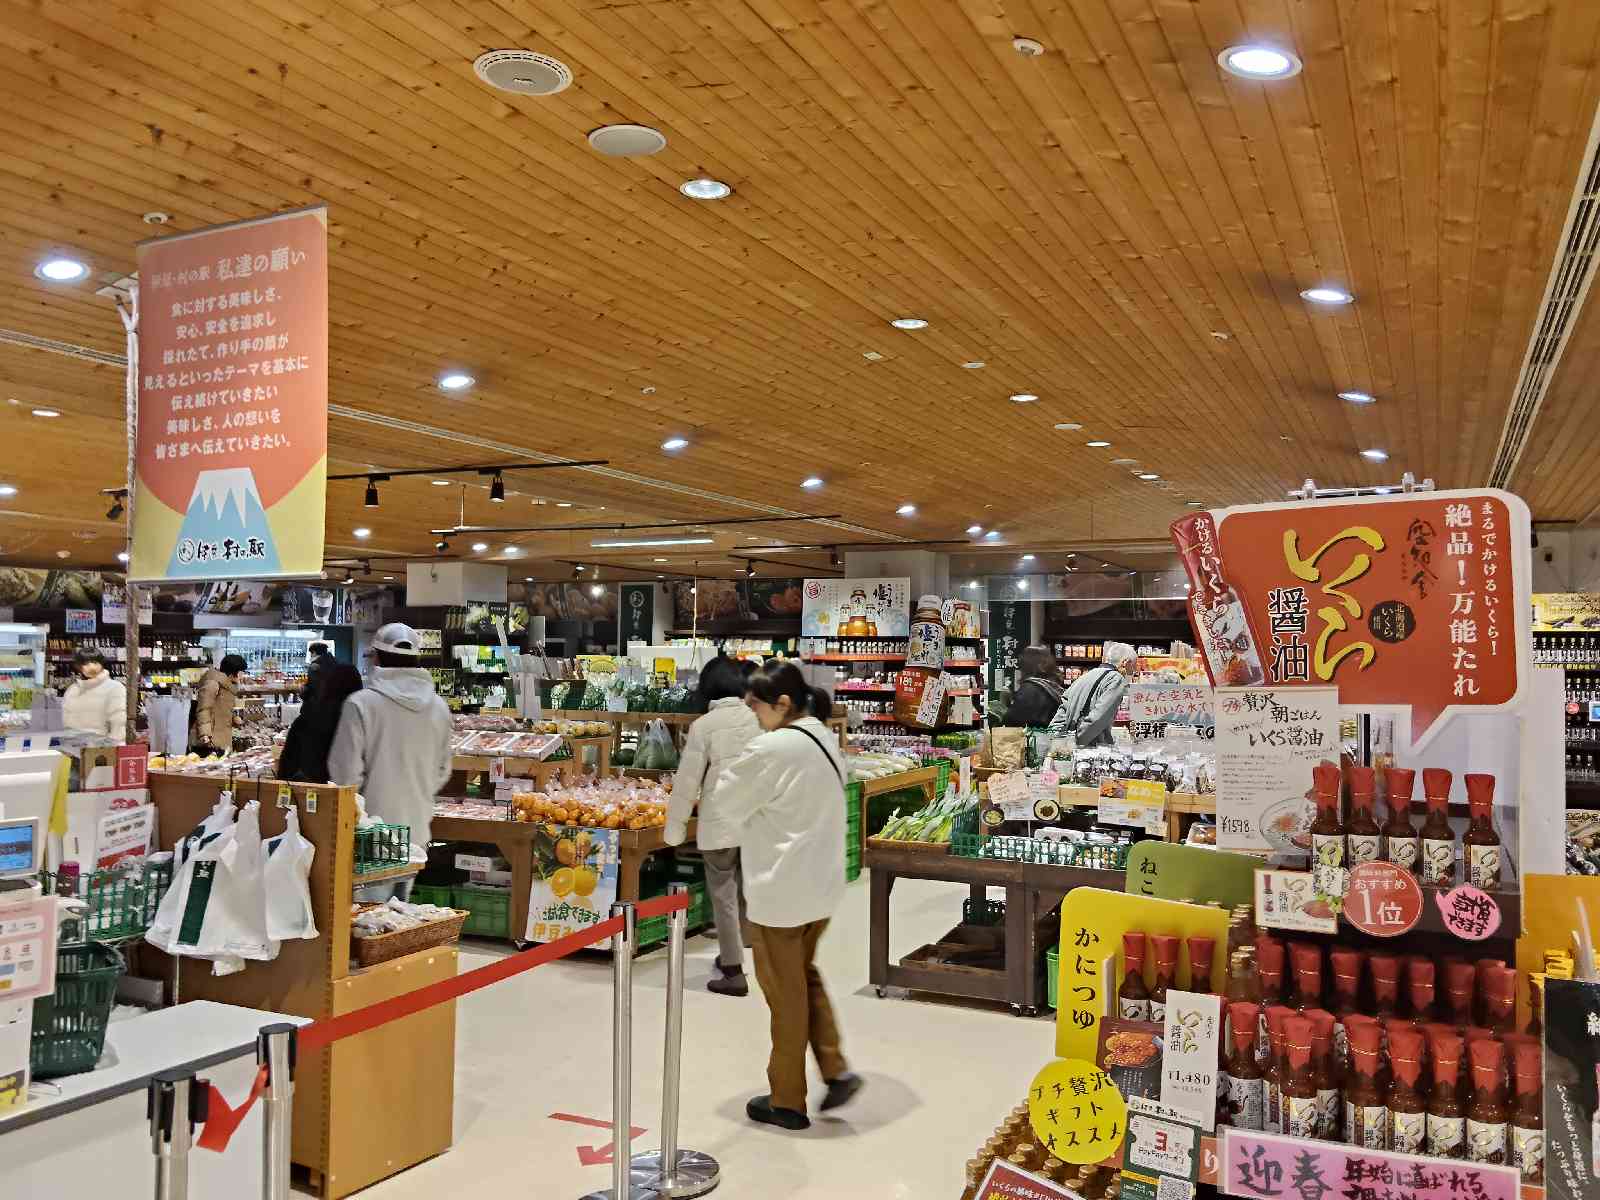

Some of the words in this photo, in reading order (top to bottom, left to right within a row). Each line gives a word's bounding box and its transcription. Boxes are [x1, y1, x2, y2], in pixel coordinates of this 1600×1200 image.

[217, 247, 306, 282] 私達の願い
[176, 312, 276, 340] 安心、安全を追求し
[144, 356, 309, 390] 見えるといったテーマを基本に
[171, 386, 278, 411] 伝え続けていきたい
[167, 408, 281, 435] 美味しさ、人の想いを
[155, 434, 291, 460] 皆さまへ伝えていきたい。
[1283, 526, 1386, 682] いくら
[1267, 587, 1310, 682] 醤油
[1242, 691, 1280, 712] 贅沢
[1271, 705, 1322, 724] 朝ごはん
[1249, 725, 1325, 748] いくら醤油
[1354, 878, 1408, 891] おすすめ
[1359, 889, 1405, 926] 1位
[1072, 927, 1100, 1030] かにつゆ
[1031, 1071, 1113, 1101] プチ贅沢
[1047, 1102, 1104, 1125] ギフト
[1047, 1122, 1121, 1151] オススメ
[1236, 1143, 1334, 1200] 迎春
